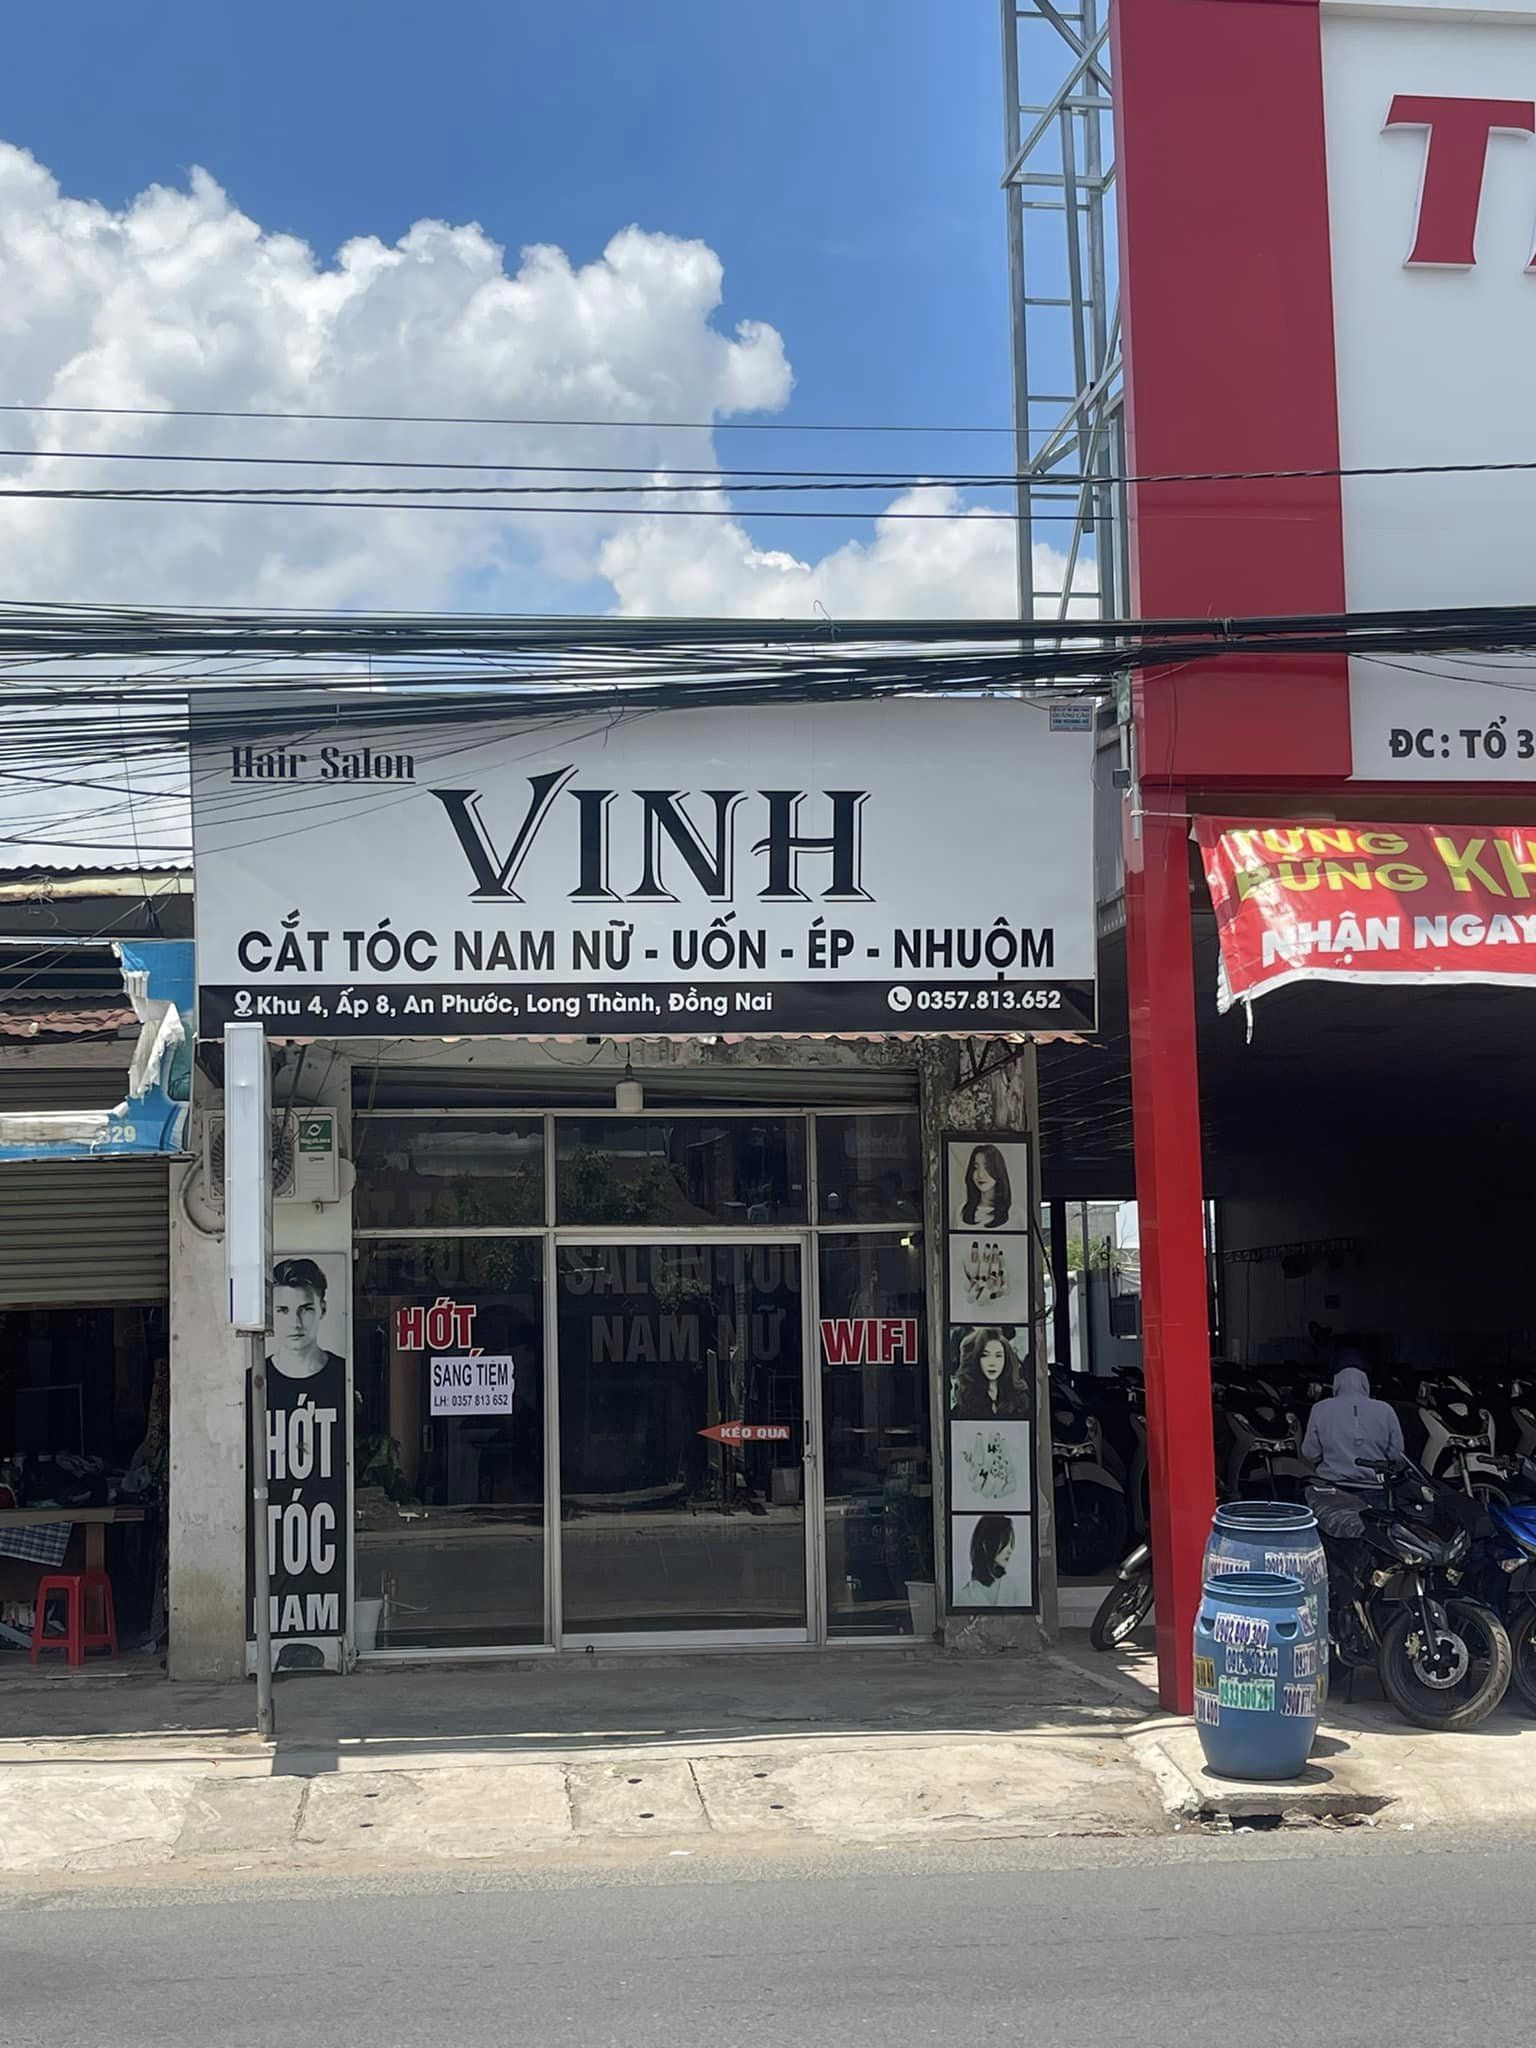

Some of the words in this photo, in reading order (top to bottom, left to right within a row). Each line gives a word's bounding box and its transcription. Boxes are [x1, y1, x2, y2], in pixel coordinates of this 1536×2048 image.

[1389, 728, 1449, 759] ĐC:
[1459, 715, 1507, 760] TỔ
[231, 745, 307, 779] Hair
[319, 745, 416, 779] Salon
[427, 764, 877, 904] VINH
[237, 909, 331, 973] CẮT
[342, 917, 438, 973] TÓC
[454, 929, 556, 971] NAM
[572, 919, 635, 971] NỮ
[672, 910, 767, 970] UỐN
[808, 915, 855, 970] ÉP
[893, 916, 1055, 981] NHUỘM
[1261, 910, 1401, 968] NHẬN
[256, 994, 300, 1016] Khu
[307, 996, 329, 1018] 4,
[335, 987, 369, 1019] Ấp
[374, 996, 397, 1018] 8,
[404, 995, 435, 1014] An
[441, 991, 520, 1017] Phước,
[526, 994, 580, 1019] Long
[586, 991, 661, 1016] Thành,
[668, 986, 728, 1017] Đồng
[735, 991, 773, 1012] Nai
[916, 989, 1062, 1011] 0357.813.652
[396, 1296, 477, 1351] HỚT
[591, 1313, 700, 1363] NAM
[820, 1318, 918, 1365] WIFI
[433, 1363, 472, 1387] SANG
[476, 1360, 509, 1392] TIỆM
[433, 1395, 449, 1407] LH:
[452, 1395, 472, 1407] 0357
[474, 1395, 490, 1406] 813
[492, 1394, 508, 1406] 652
[720, 1422, 752, 1439] KÉO
[756, 1426, 789, 1440] QUA
